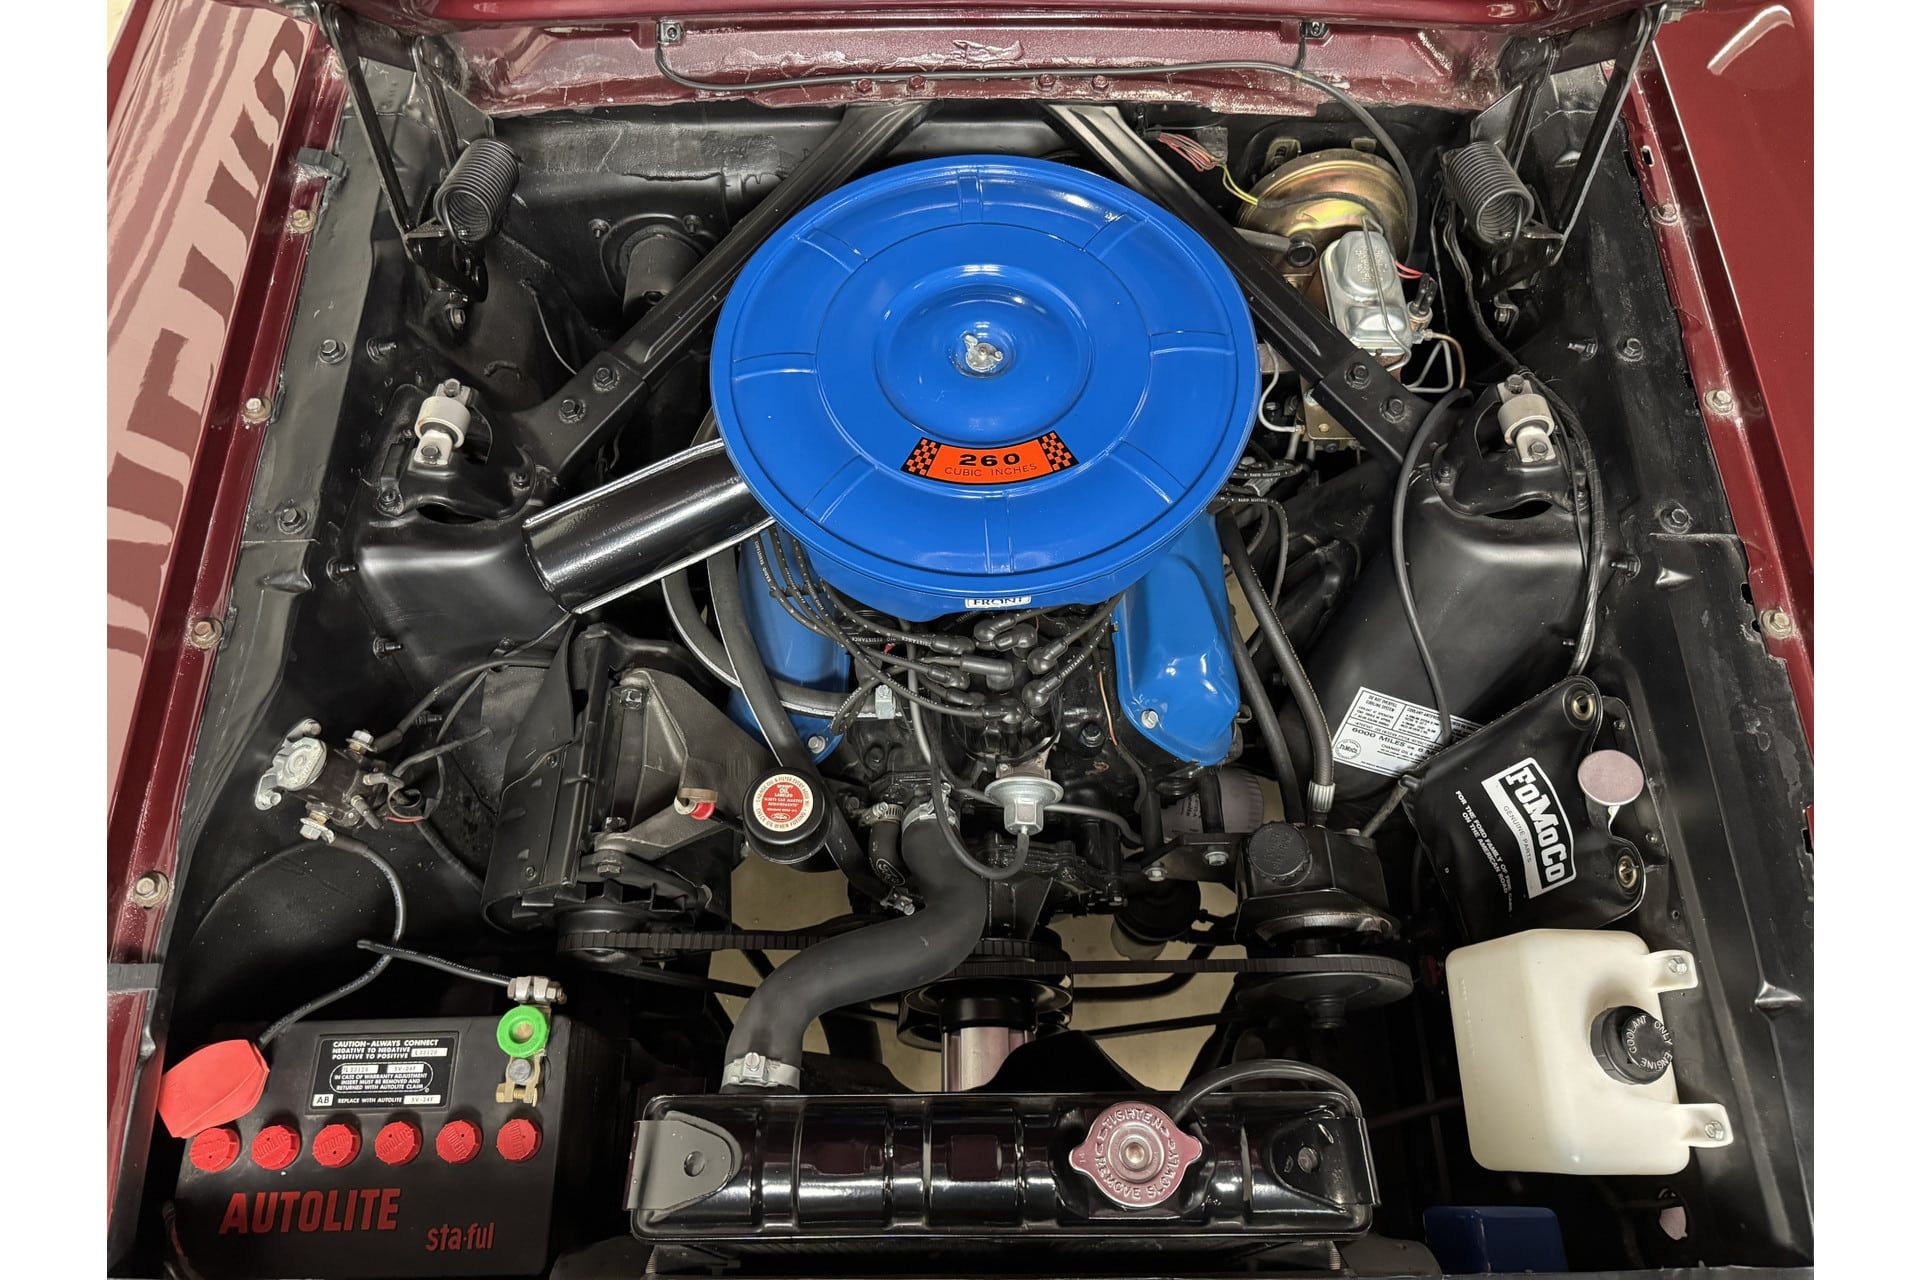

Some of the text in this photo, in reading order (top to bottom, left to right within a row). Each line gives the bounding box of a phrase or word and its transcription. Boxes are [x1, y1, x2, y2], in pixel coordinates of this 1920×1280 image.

[944, 463, 1038, 477] CUBIC INCHES
[959, 453, 1020, 467] 260
[974, 597, 1023, 605] FRONT
[1352, 727, 1376, 738] 6000
[1379, 735, 1405, 747] MILES
[1455, 790, 1468, 805] FOR
[1465, 805, 1477, 819] THE
[1474, 819, 1487, 839] FORD
[1485, 838, 1503, 862] FAMILY
[1500, 864, 1508, 874] OF
[1503, 805, 1532, 863] GENUINE PARTS
[1505, 766, 1568, 883] FoMoCo
[1462, 812, 1508, 894] ON THE AMERICAN ROAD
[404, 1039, 439, 1047] CONNECT
[1626, 1015, 1674, 1072] ENGINE COOLANT ONLY
[316, 1096, 330, 1104] AB
[1102, 1108, 1164, 1130] TIGHTEN
[1095, 1153, 1181, 1200] REMOVE SLOWLY
[218, 1188, 401, 1235] AUTOLITE
